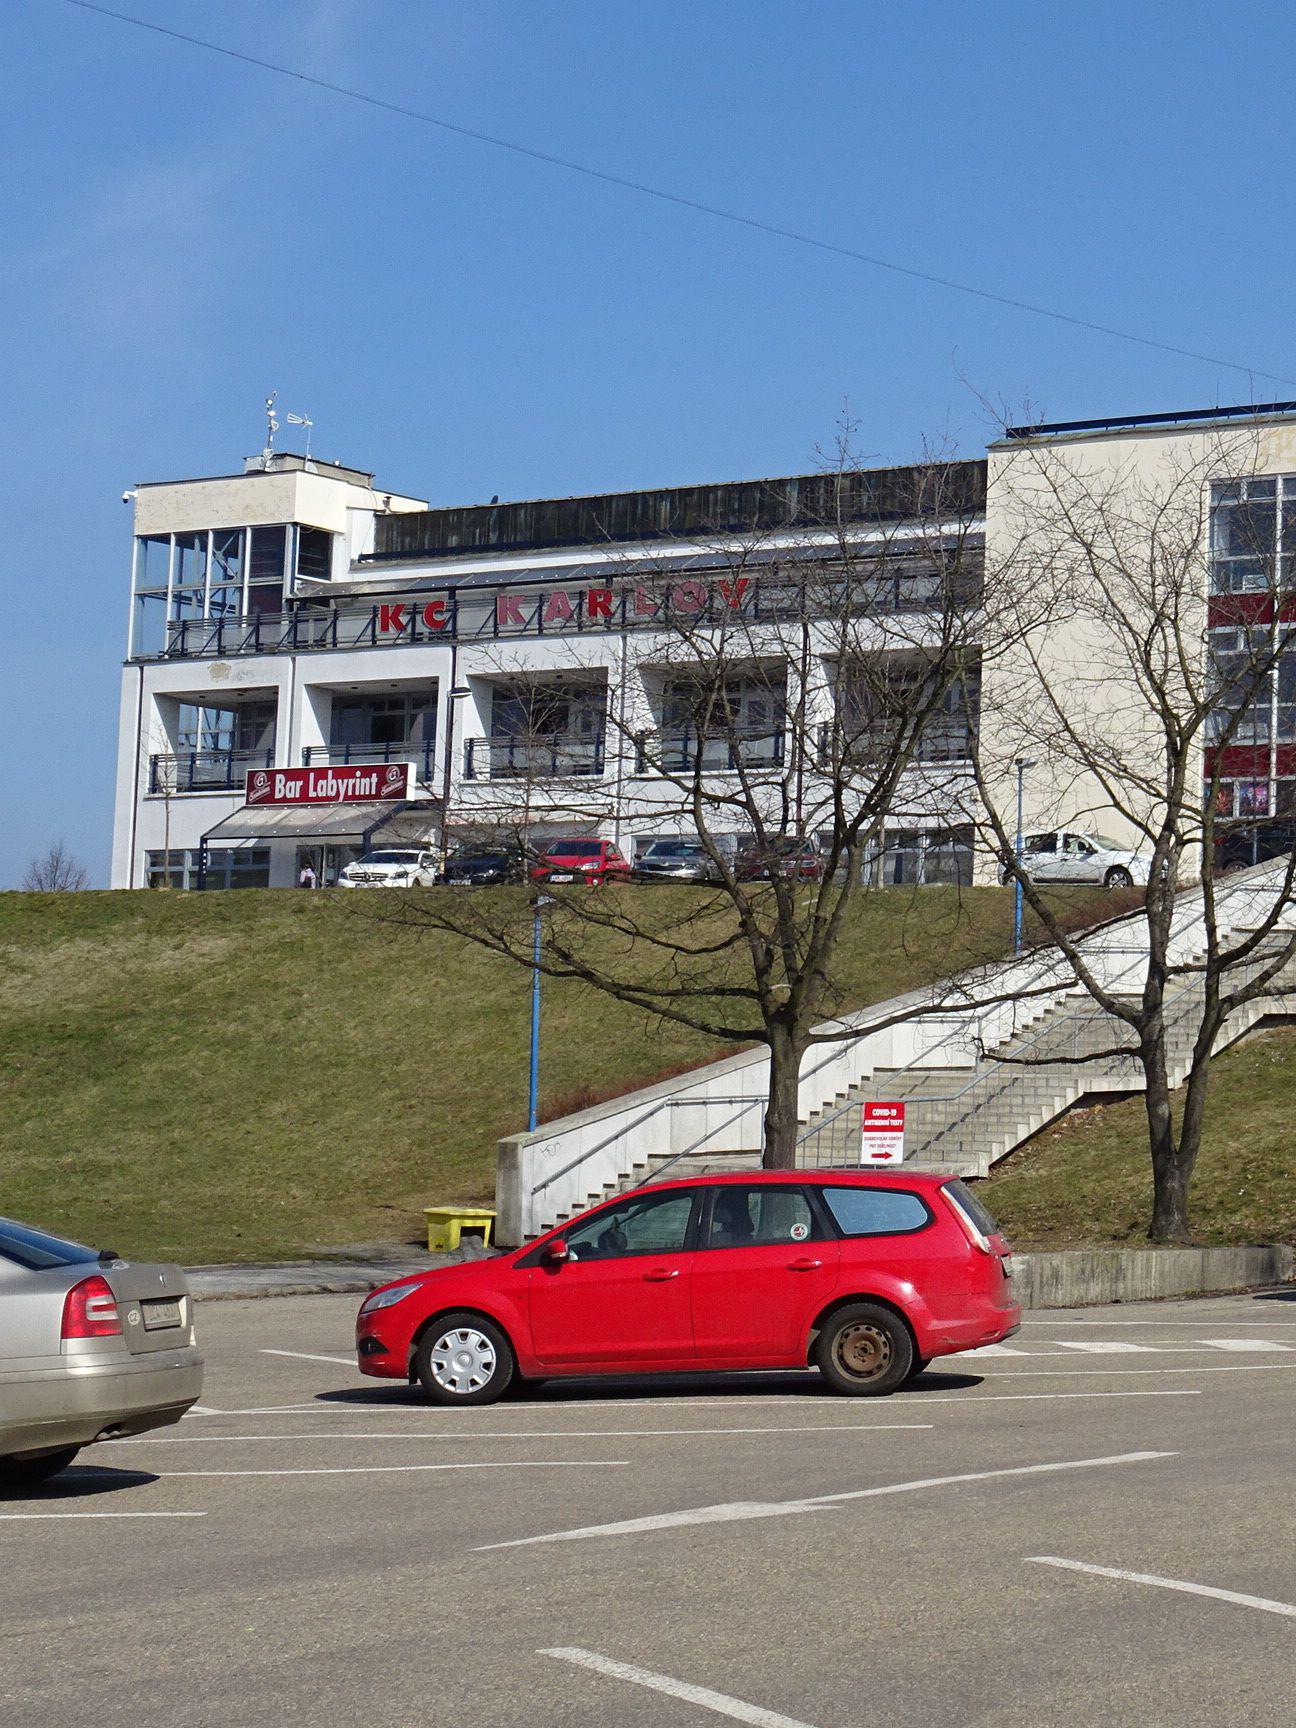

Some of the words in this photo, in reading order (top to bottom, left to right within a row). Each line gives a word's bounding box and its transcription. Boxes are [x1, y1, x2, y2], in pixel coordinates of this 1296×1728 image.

[379, 601, 447, 634] KC
[497, 577, 750, 626] KARLOV
[275, 774, 303, 799] Bar
[309, 770, 378, 802] Labyrint
